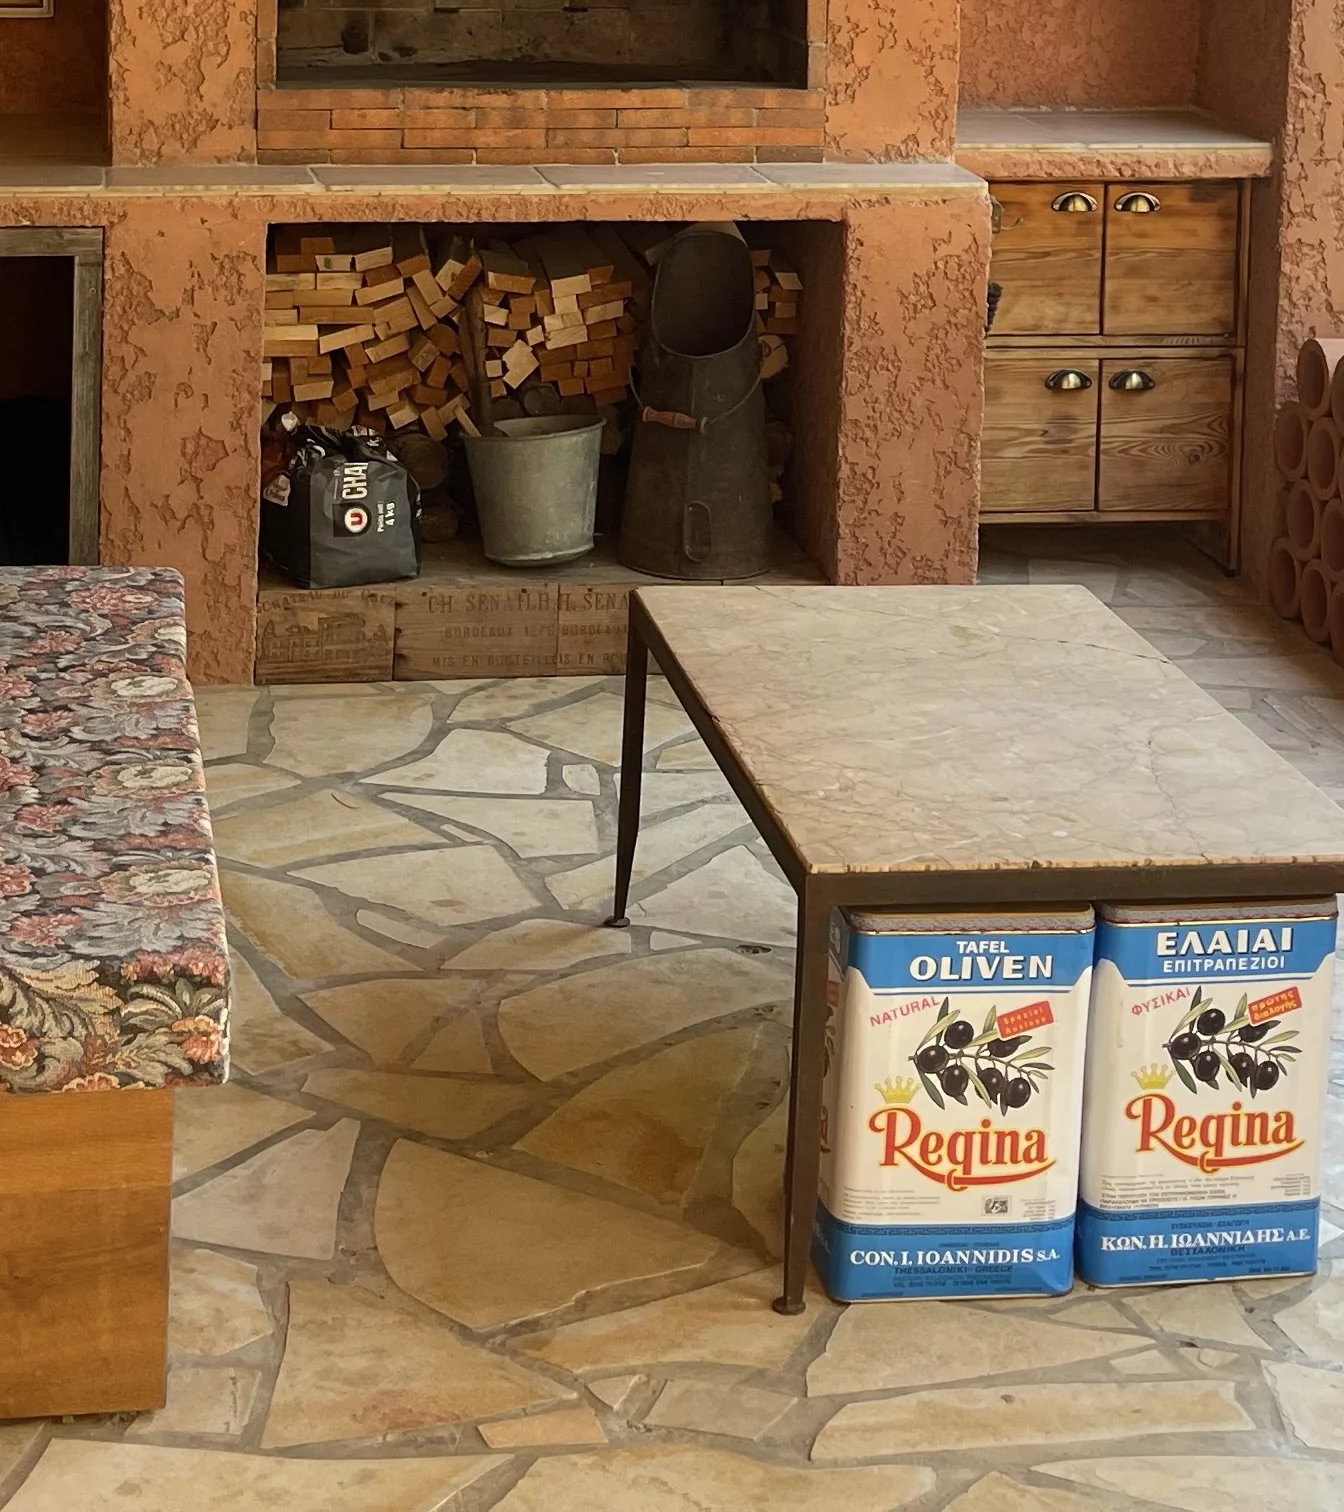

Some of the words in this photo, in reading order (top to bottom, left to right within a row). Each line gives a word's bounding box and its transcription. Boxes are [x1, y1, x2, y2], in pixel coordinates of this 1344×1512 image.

[956, 940, 1010, 954] TAFEL
[1156, 927, 1294, 957] ΕΛΑΙΑΙ
[909, 955, 1054, 982] OLIVEN
[1163, 956, 1285, 973] ΕΠΙΤΡΑΠΕΖΙΟΙ
[870, 996, 941, 1027] NATURAL
[1131, 986, 1191, 1016] ΦΥΣΙΚΑΙ
[1125, 1093, 1306, 1174] Regina
[868, 1106, 1056, 1192] Regina
[1170, 1228, 1284, 1249] ΙΩΑΝΝΙΔΗΣ
[917, 1248, 1034, 1265] IOANNIDIS
